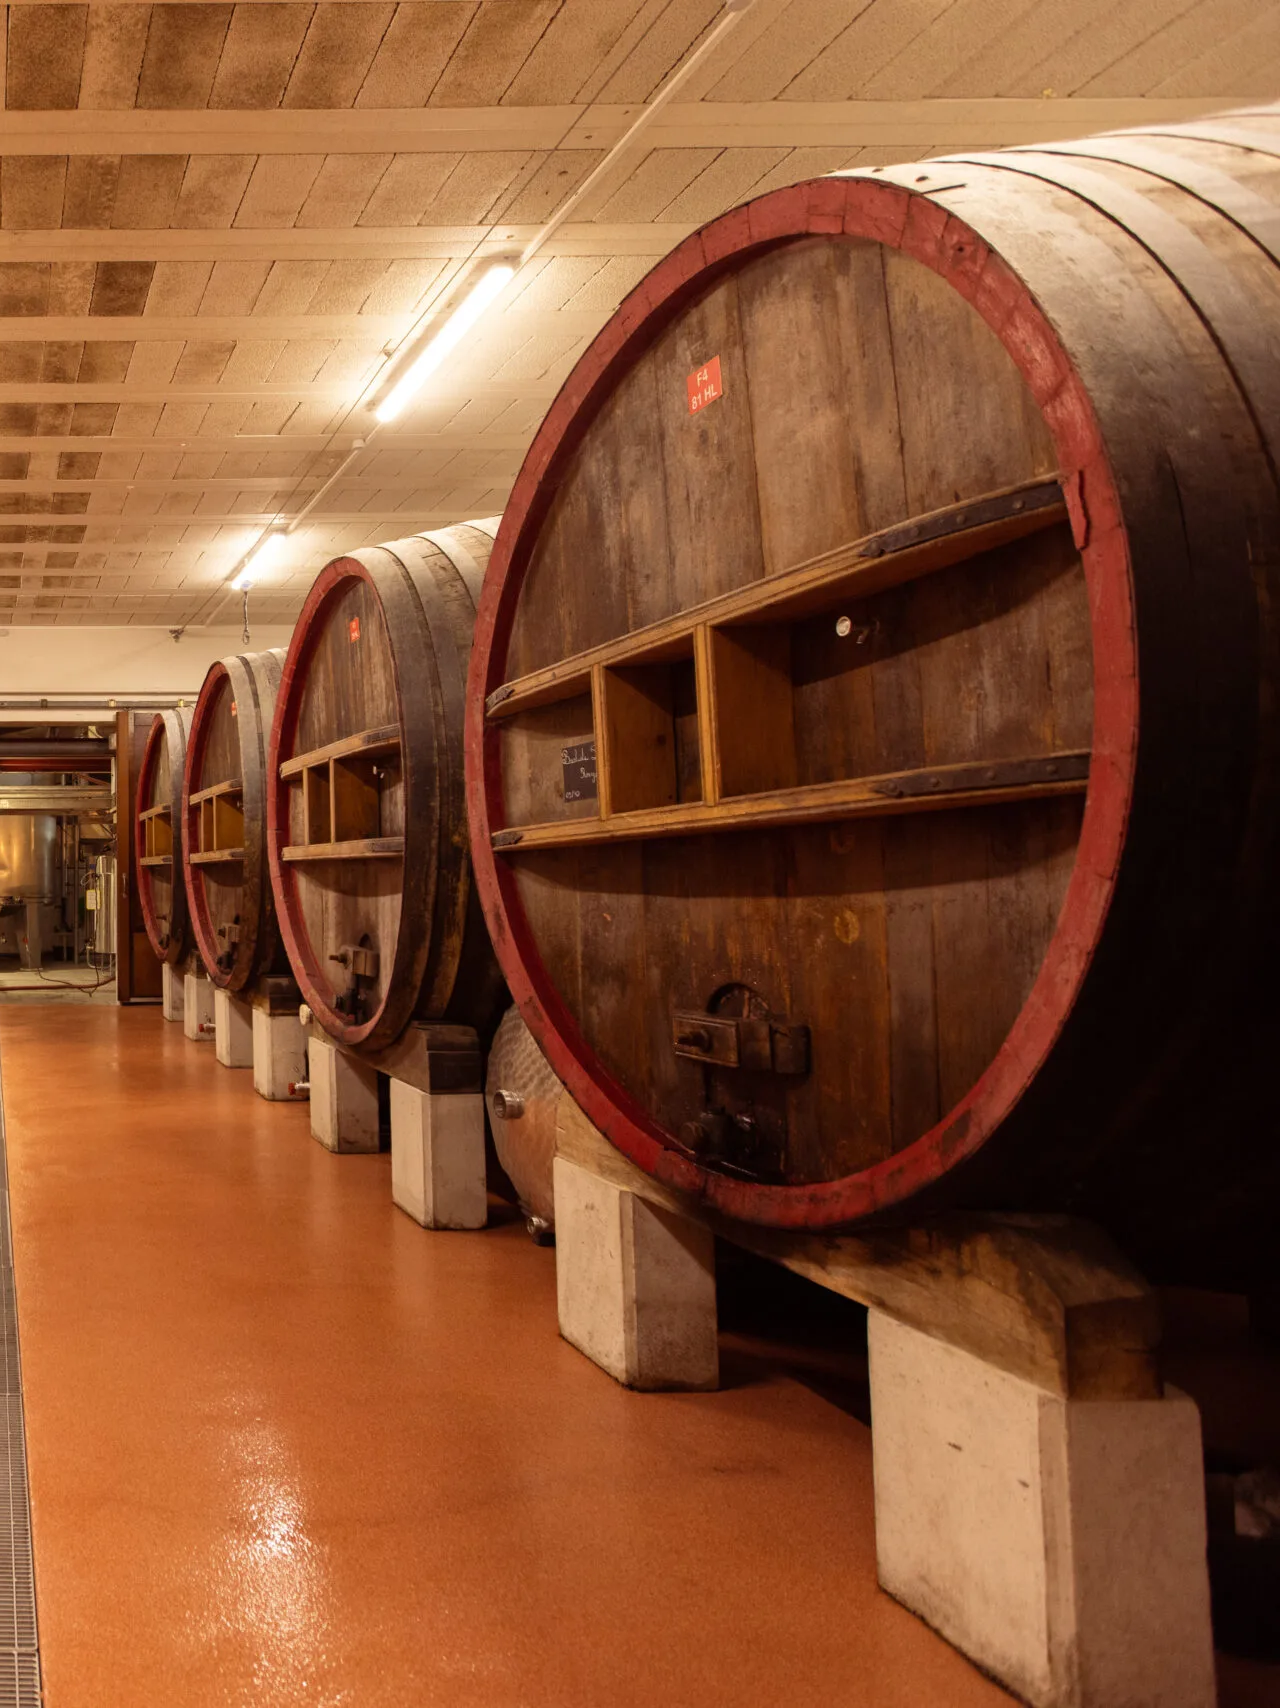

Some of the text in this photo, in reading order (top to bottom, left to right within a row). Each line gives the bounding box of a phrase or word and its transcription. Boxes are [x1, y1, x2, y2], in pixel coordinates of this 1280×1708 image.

[697, 369, 708, 388] F4
[692, 384, 717, 410] 81 HL
